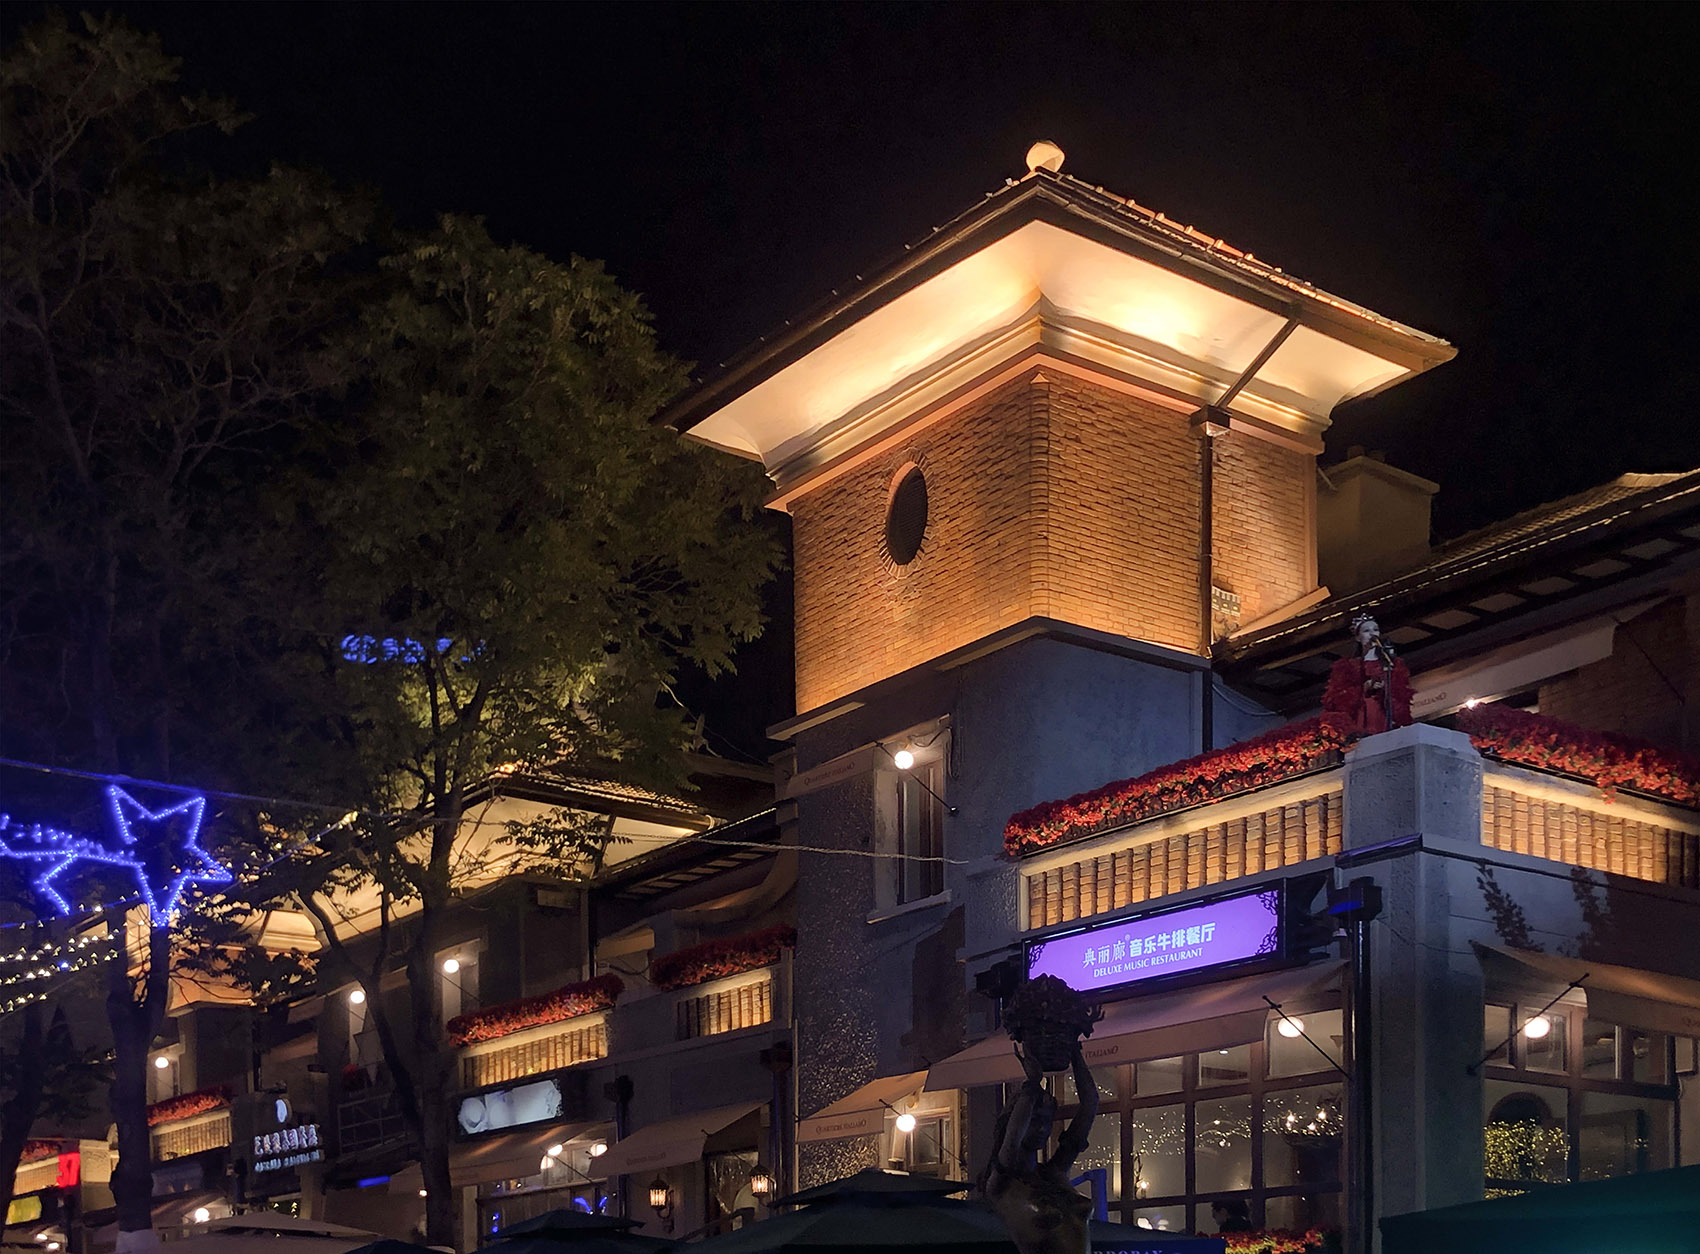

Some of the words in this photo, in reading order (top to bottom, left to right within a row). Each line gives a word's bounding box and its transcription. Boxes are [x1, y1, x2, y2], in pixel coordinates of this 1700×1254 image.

[1093, 964, 1122, 978] DELUXE
[1123, 958, 1150, 971] MUSIC
[1151, 947, 1203, 967] RESTAURANT
